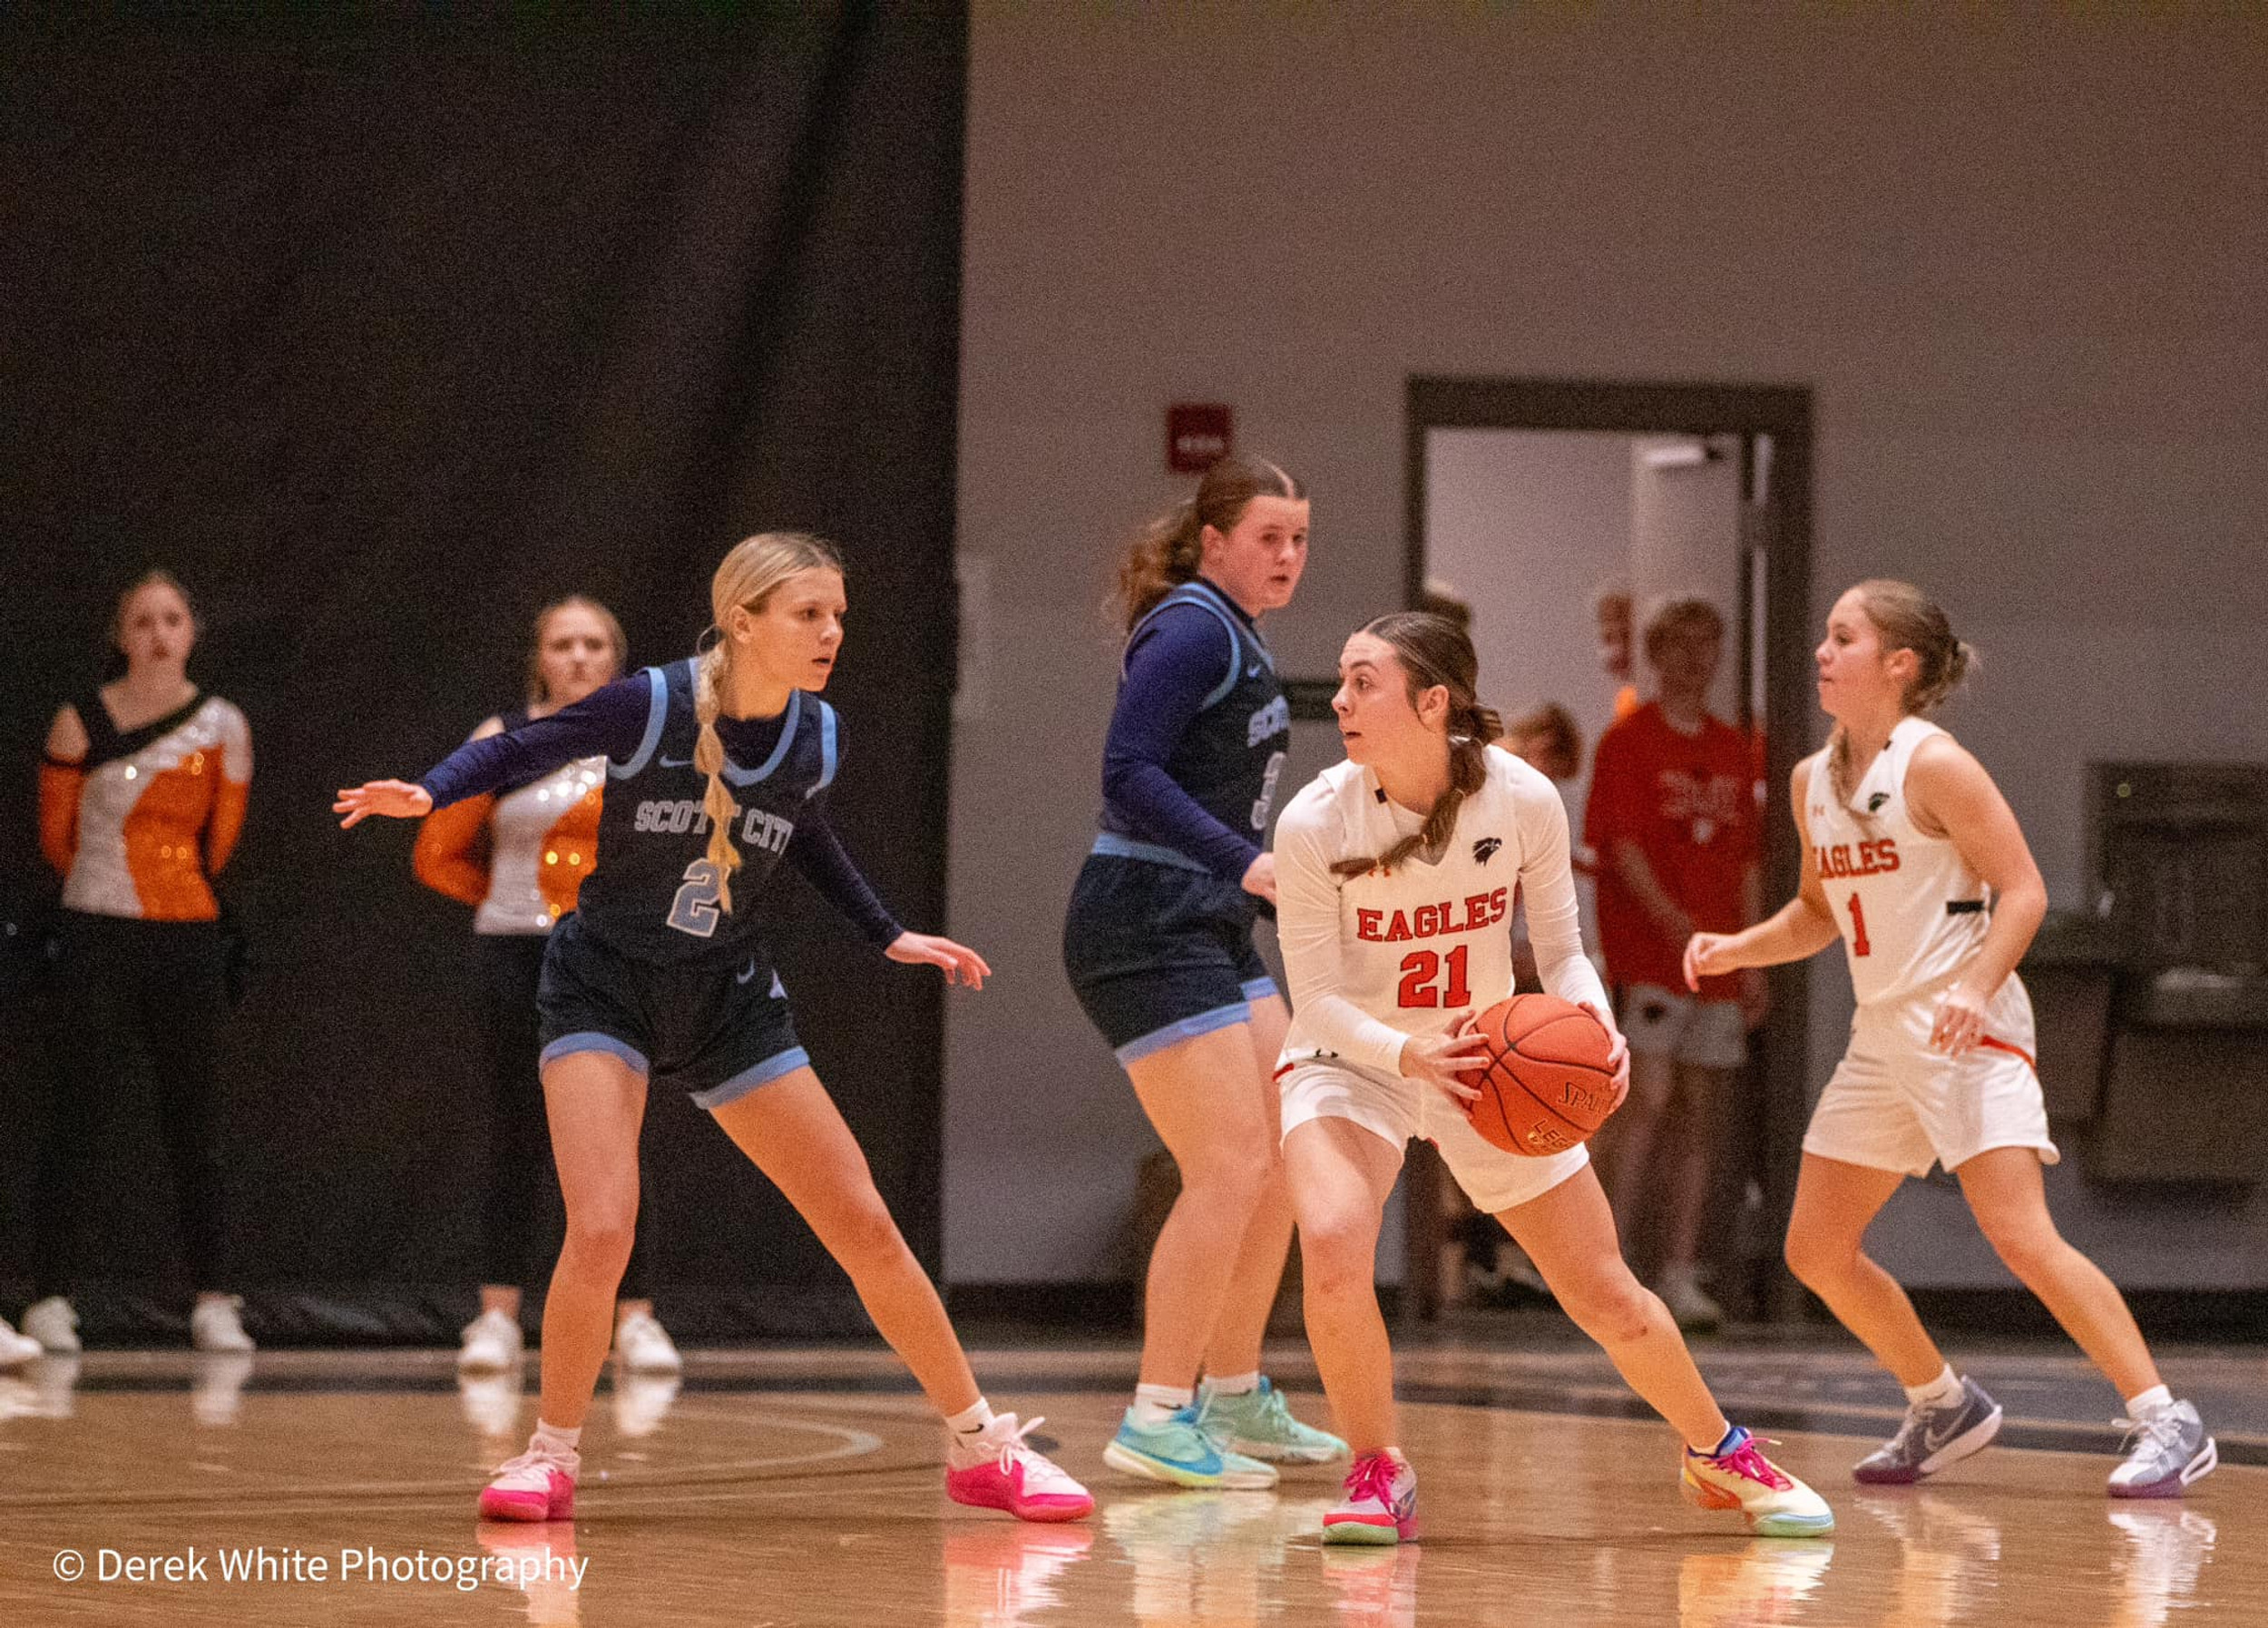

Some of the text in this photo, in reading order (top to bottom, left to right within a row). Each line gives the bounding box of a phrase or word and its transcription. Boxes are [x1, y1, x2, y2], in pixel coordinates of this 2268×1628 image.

[634, 799, 742, 836] SCOT
[1813, 839, 1901, 878] AGLES
[666, 857, 731, 937] 2
[1356, 887, 1508, 942] EAGLES
[1848, 892, 1871, 956] 1
[1397, 945, 1471, 1009] 21
